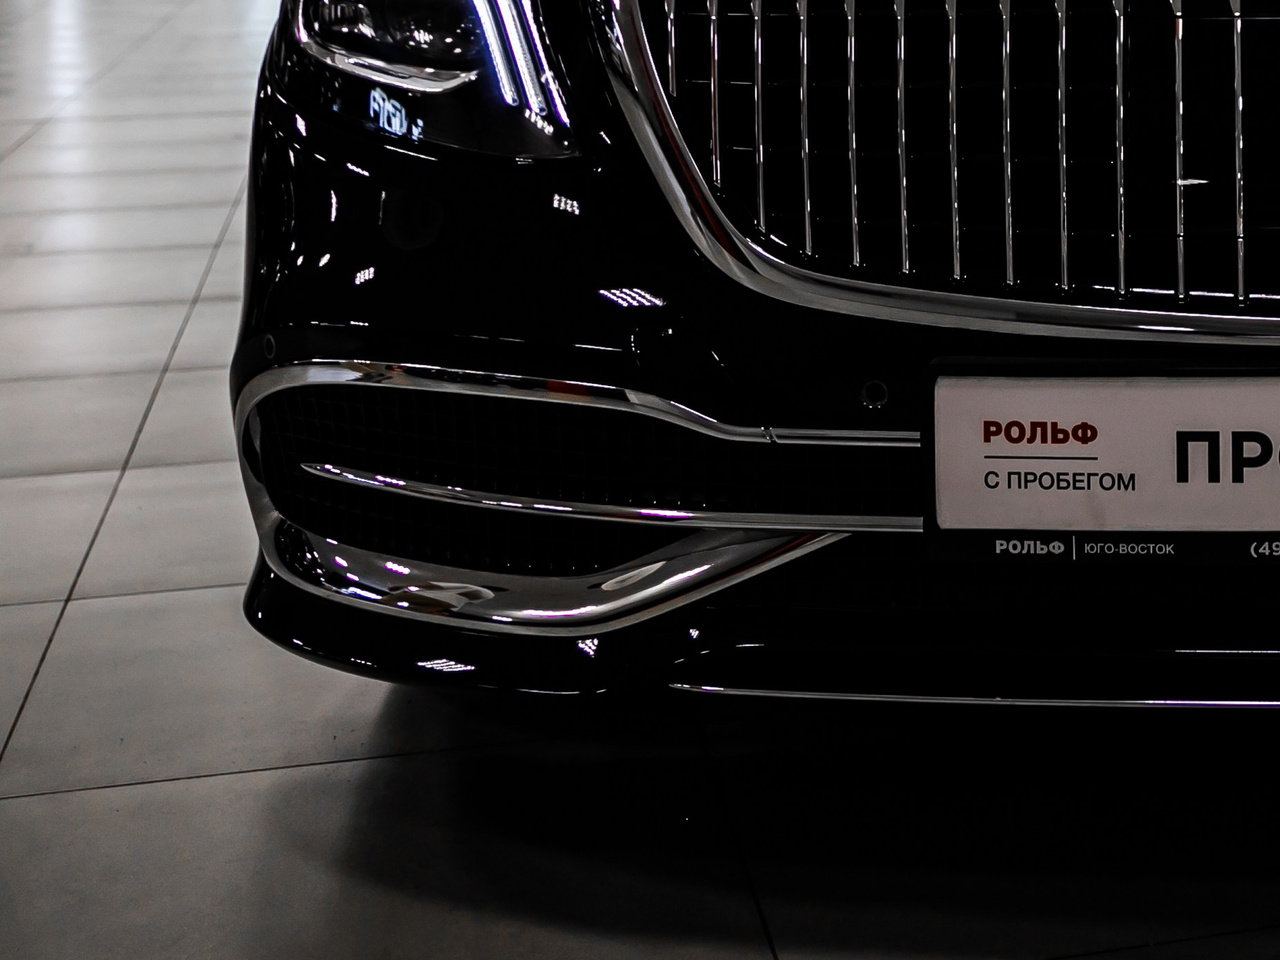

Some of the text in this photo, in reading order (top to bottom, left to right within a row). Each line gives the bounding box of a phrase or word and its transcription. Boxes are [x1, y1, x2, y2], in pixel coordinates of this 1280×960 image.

[982, 420, 1099, 445] РОЛЬФ
[984, 470, 1136, 492] С ПРОБЕГОМ
[995, 539, 1176, 556] РОЛЬФ ЮГО-ВОСТОК
